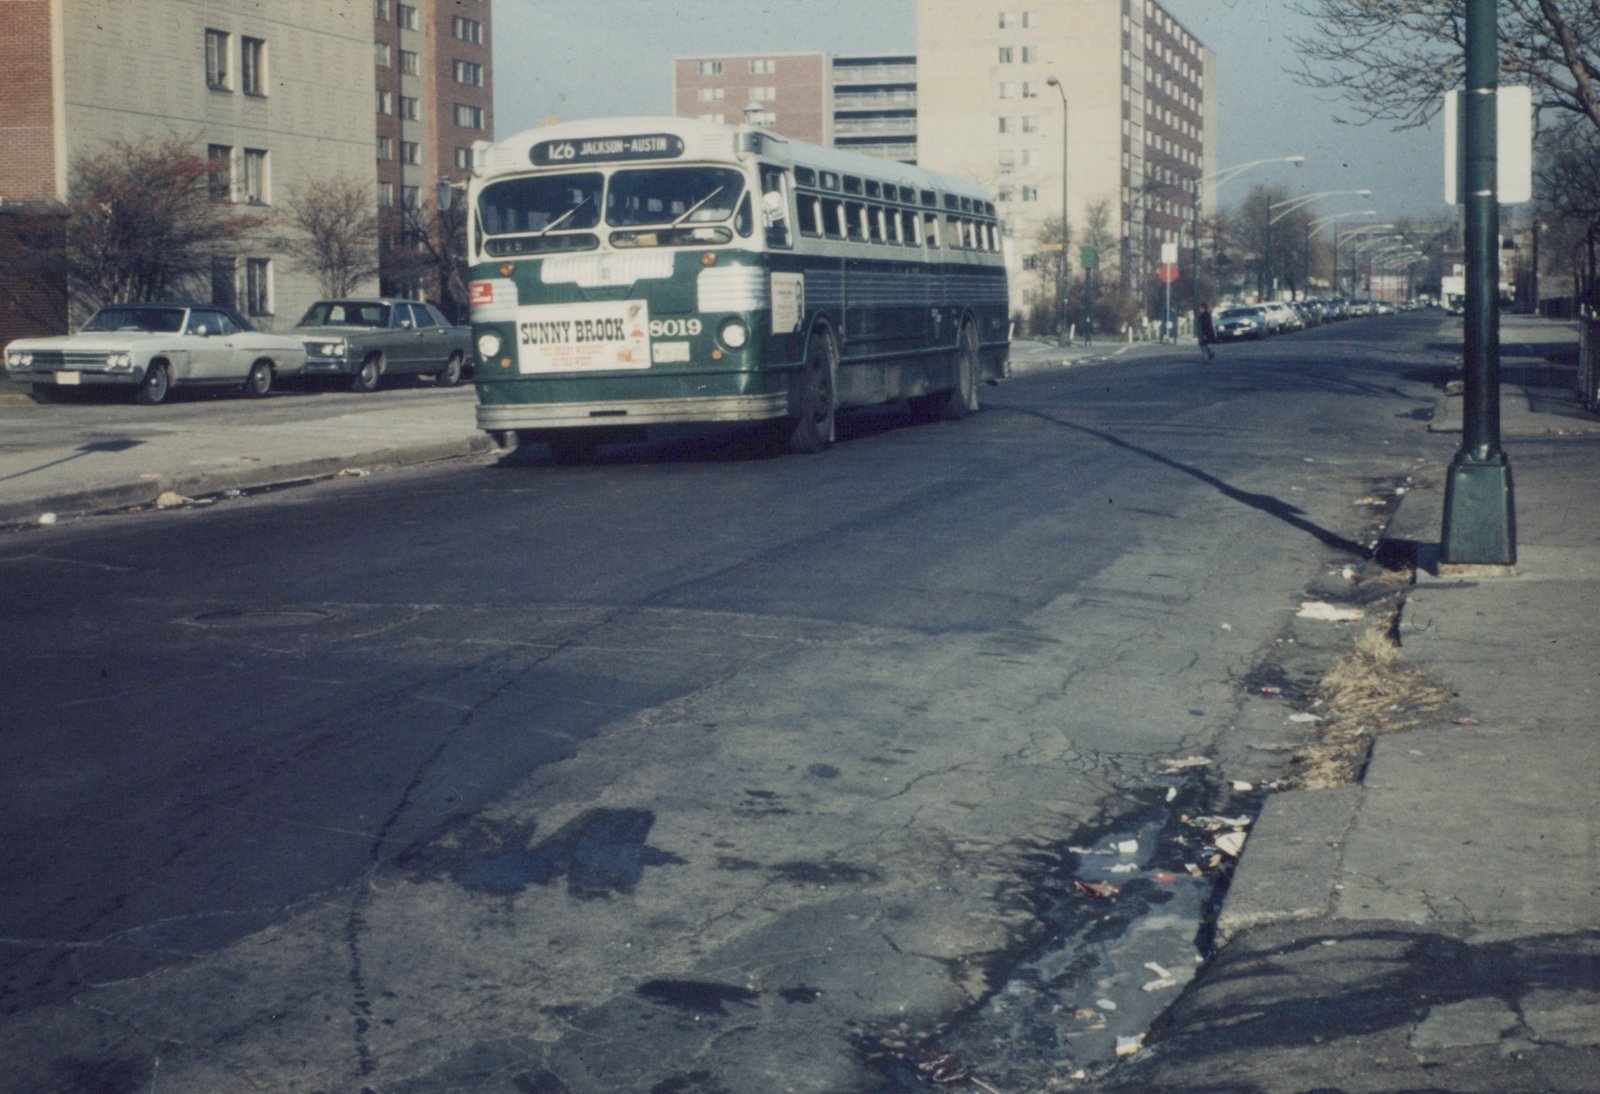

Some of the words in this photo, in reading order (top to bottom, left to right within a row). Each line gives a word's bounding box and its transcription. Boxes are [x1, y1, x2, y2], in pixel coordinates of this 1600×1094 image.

[548, 144, 575, 160] 126
[579, 138, 668, 156] JACKSON-AUSTIN
[520, 321, 571, 345] SUNNY
[574, 317, 625, 343] BROOK
[649, 318, 702, 337] 8019
